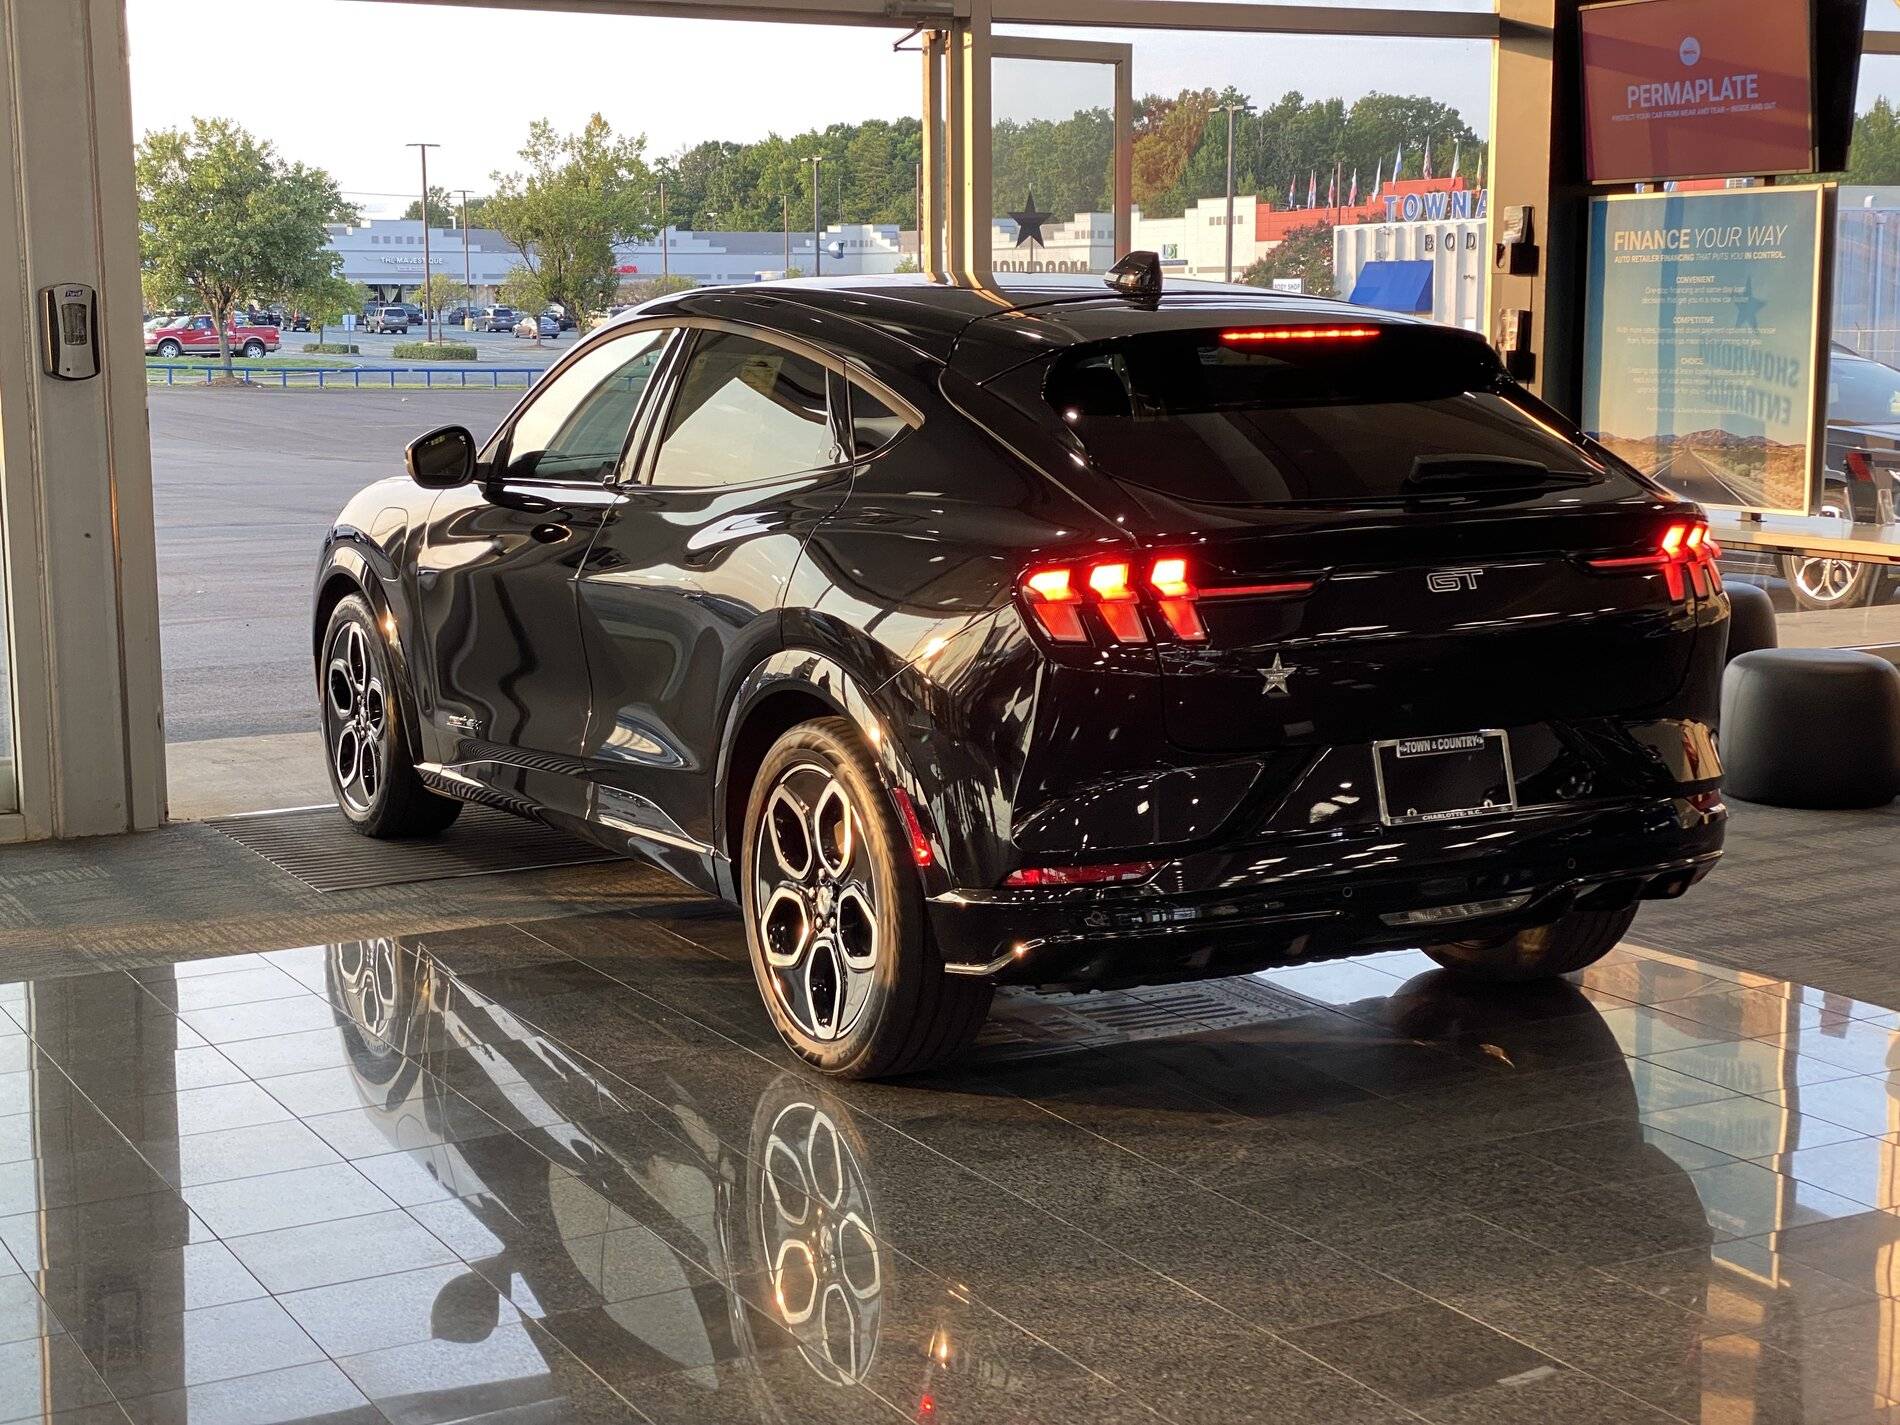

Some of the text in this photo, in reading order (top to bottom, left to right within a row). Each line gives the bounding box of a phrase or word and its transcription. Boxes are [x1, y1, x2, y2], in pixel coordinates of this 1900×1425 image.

[1627, 74, 1759, 109] PERMAPLATE
[1614, 224, 1788, 251] FINANCE YOUR WAY
[1615, 255, 1631, 263] AUTO
[1426, 568, 1483, 592] GT
[1405, 740, 1430, 753] TOWN
[1437, 735, 1477, 750] COUNTRY
